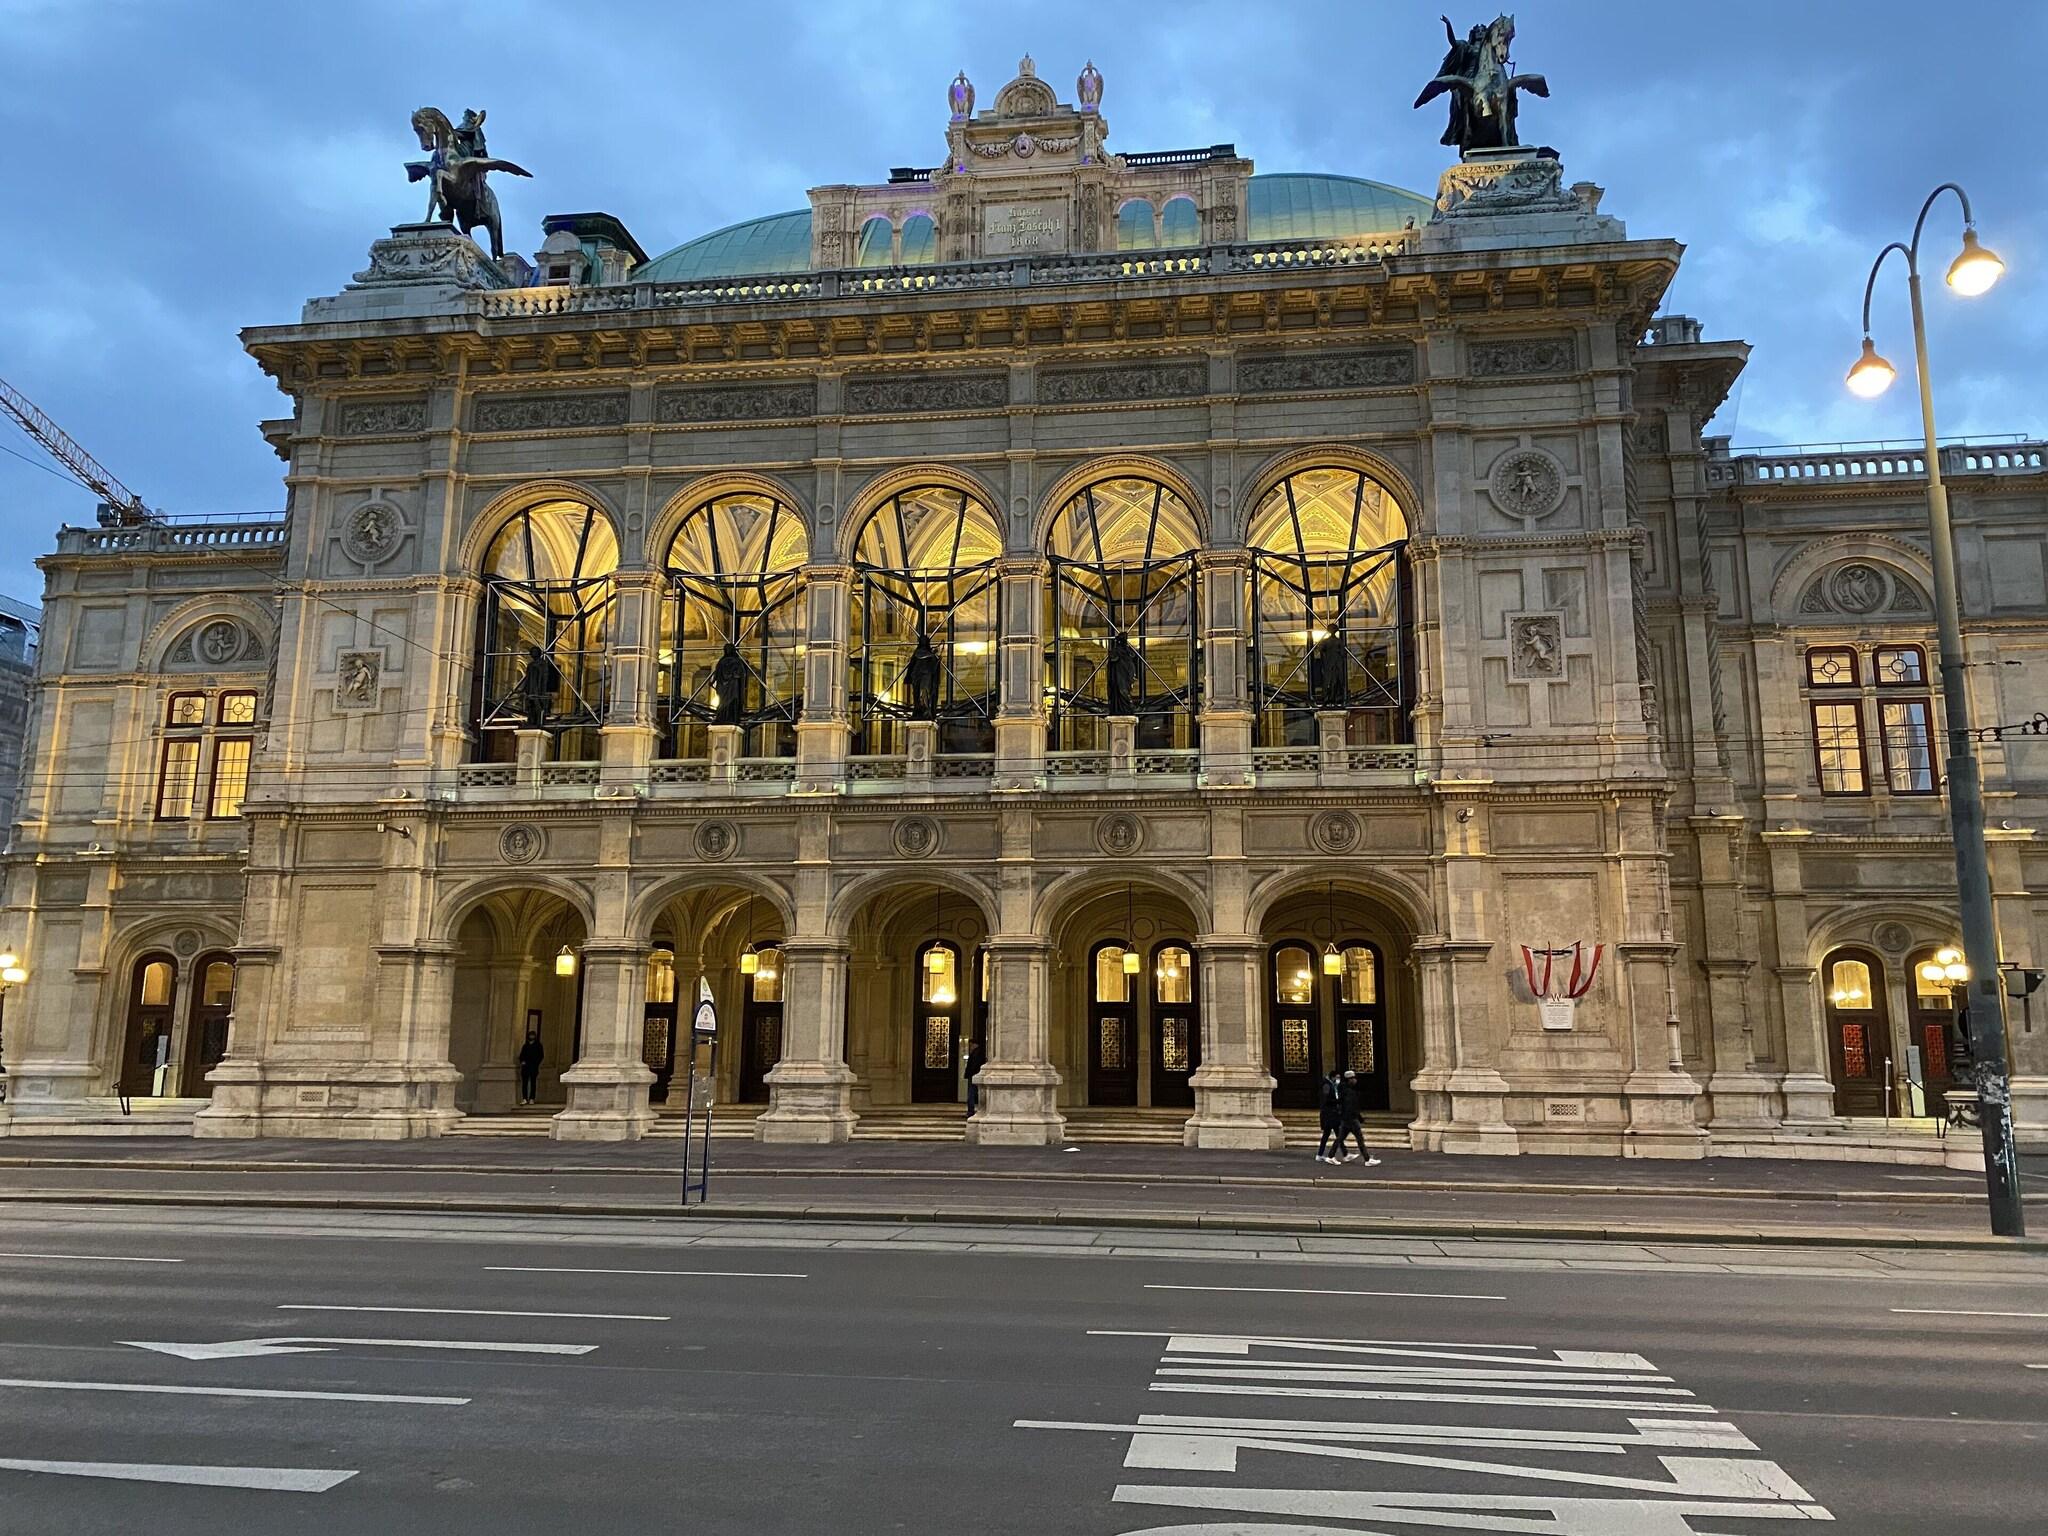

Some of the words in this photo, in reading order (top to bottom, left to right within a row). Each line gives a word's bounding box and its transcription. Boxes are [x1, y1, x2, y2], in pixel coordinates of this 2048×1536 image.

[1009, 207, 1042, 218] Kaiser
[988, 220, 1017, 237] Franz
[1018, 217, 1054, 236] Joseph
[1011, 236, 1039, 248] 1868
[1138, 1336, 1761, 1450] LINZ
[1111, 1433, 1836, 1536] AZ
